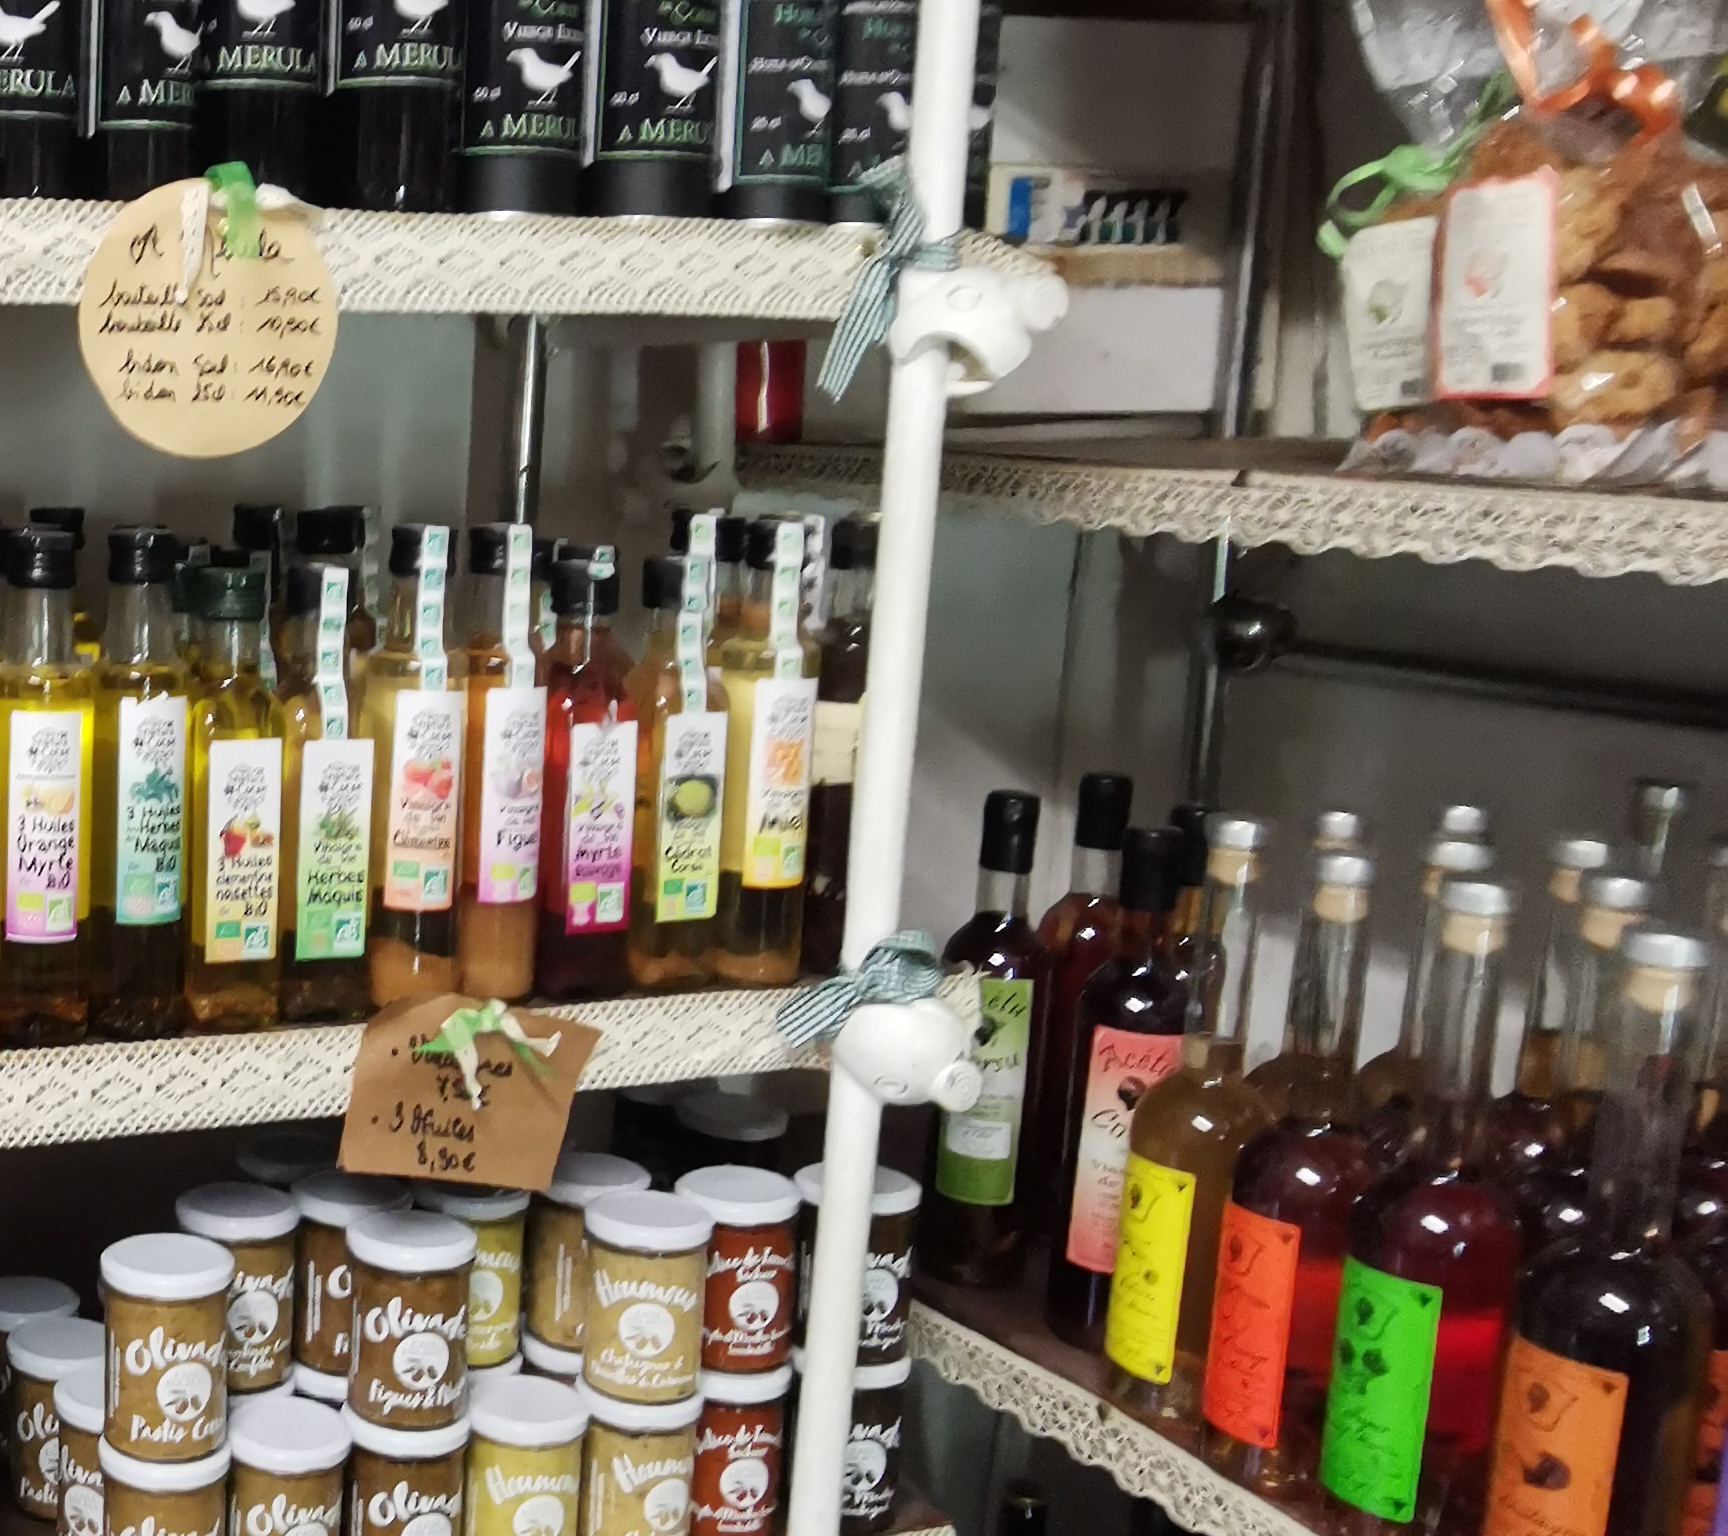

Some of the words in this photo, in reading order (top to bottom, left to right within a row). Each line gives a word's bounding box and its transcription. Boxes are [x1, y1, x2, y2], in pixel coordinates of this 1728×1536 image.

[216, 44, 317, 75] MERULA
[374, 42, 464, 73] MERUL
[126, 805, 135, 821] 3
[18, 817, 26, 832] 3
[31, 815, 76, 834] Huiles
[16, 834, 76, 856] Orange
[16, 855, 75, 877] Myrte
[306, 869, 366, 887] Herbes
[306, 887, 365, 907] Maquis
[593, 1267, 698, 1313] Houmous
[124, 1325, 228, 1376] Olivad
